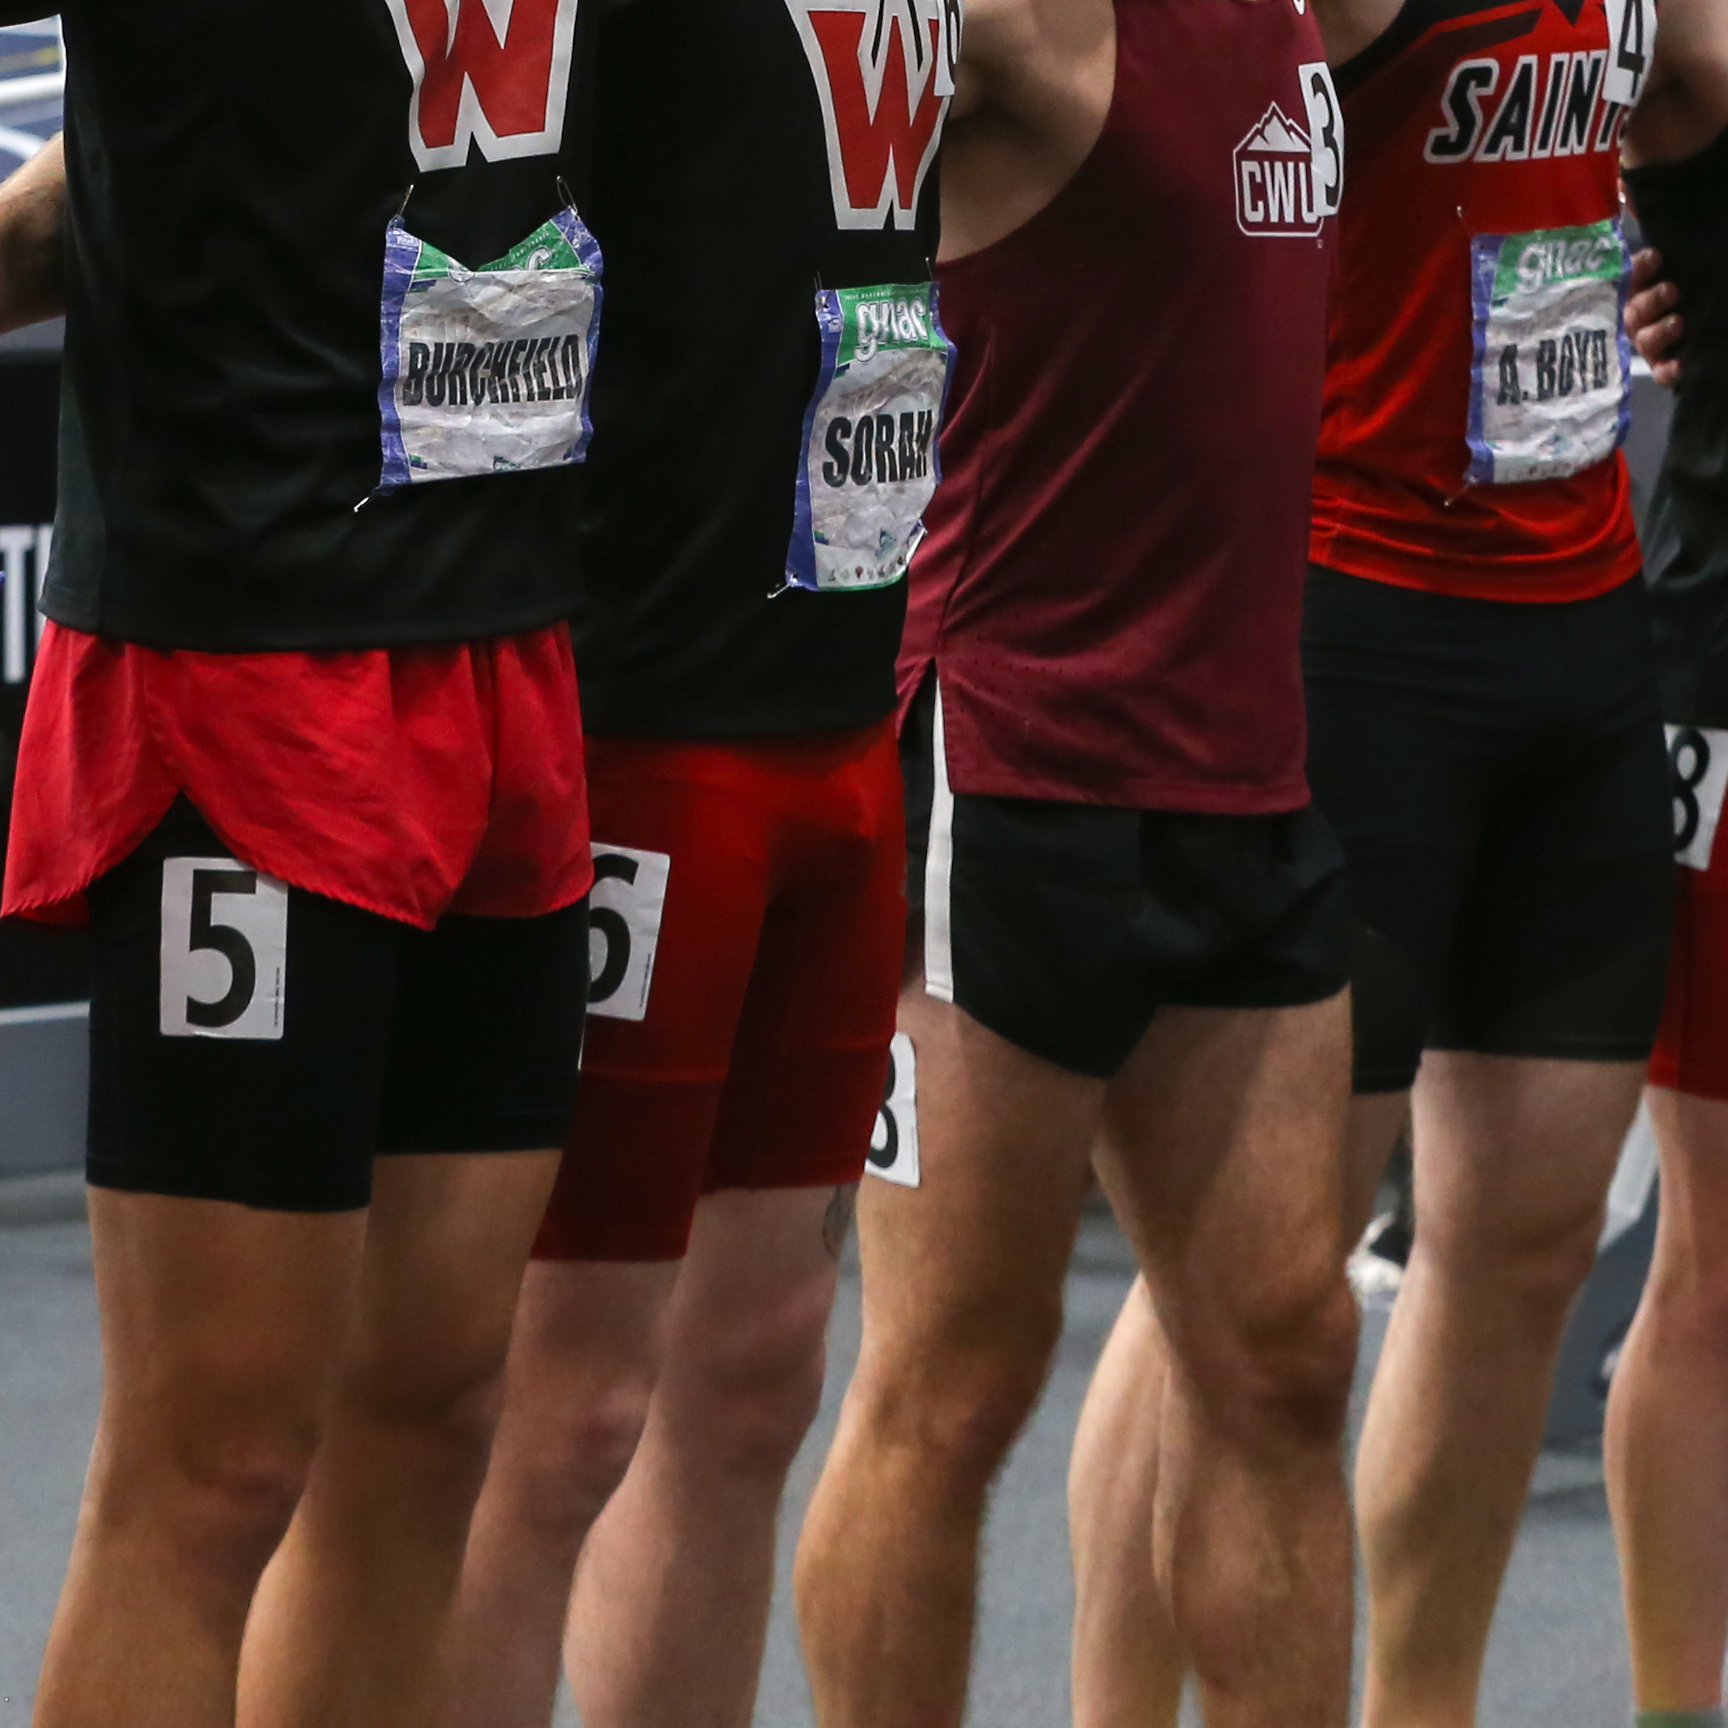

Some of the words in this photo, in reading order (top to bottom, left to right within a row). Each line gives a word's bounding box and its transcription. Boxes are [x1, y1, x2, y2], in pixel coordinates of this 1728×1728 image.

[1311, 72, 1341, 209] 3
[1241, 160, 1319, 223] CWU
[1516, 236, 1614, 296] gnac
[855, 296, 929, 364] gnac
[402, 334, 584, 407] BURCHFIELD
[822, 409, 933, 489] SORAH
[1670, 728, 1711, 851] 8
[186, 868, 257, 1028] 5
[586, 853, 640, 1003] 6
